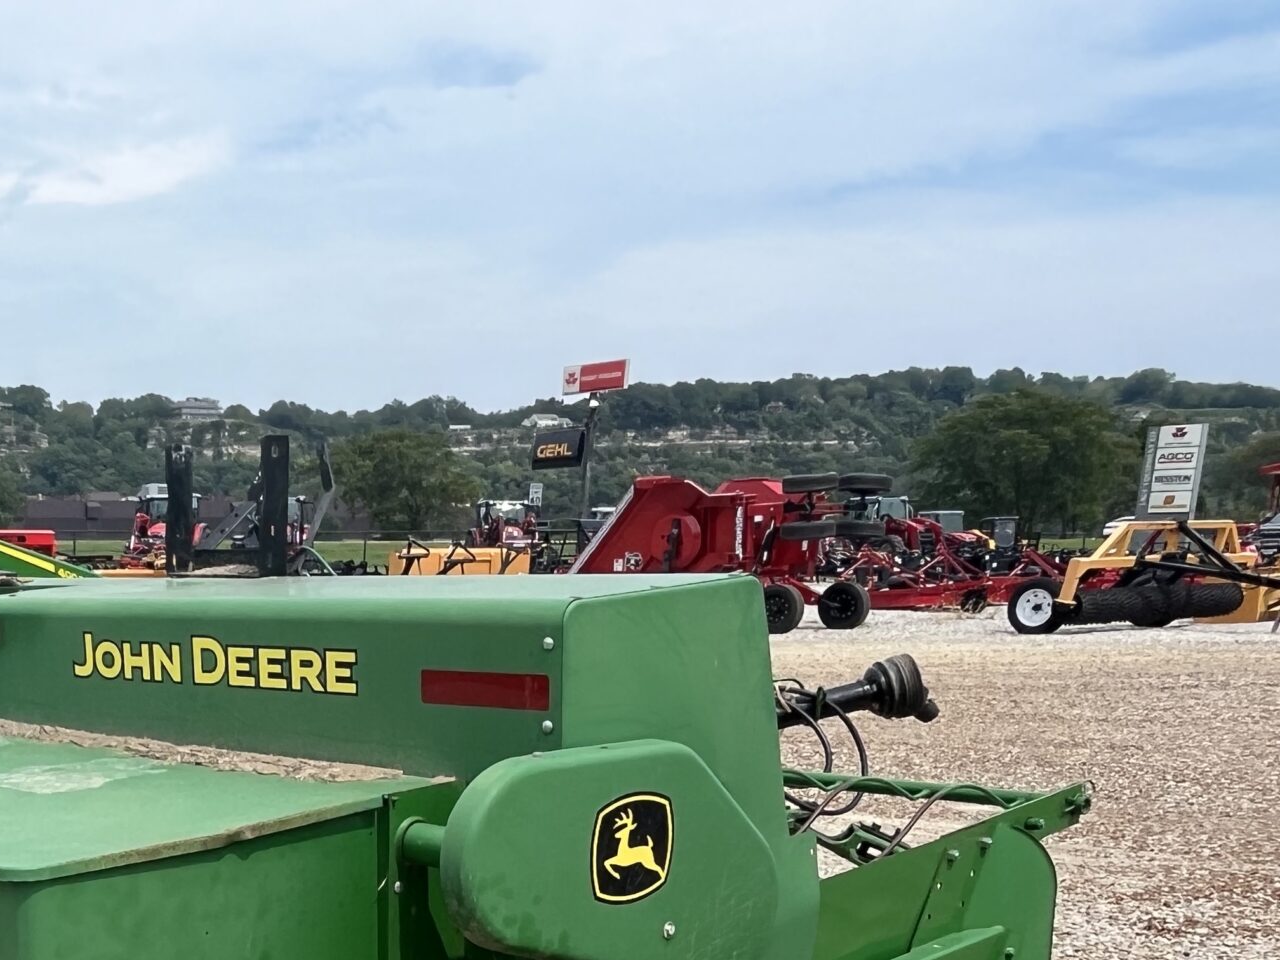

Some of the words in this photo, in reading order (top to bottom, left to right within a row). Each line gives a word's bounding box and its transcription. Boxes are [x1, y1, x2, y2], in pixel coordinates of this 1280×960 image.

[536, 443, 573, 458] GEHL
[73, 631, 182, 684] JOHN
[190, 634, 359, 697] DEERE
